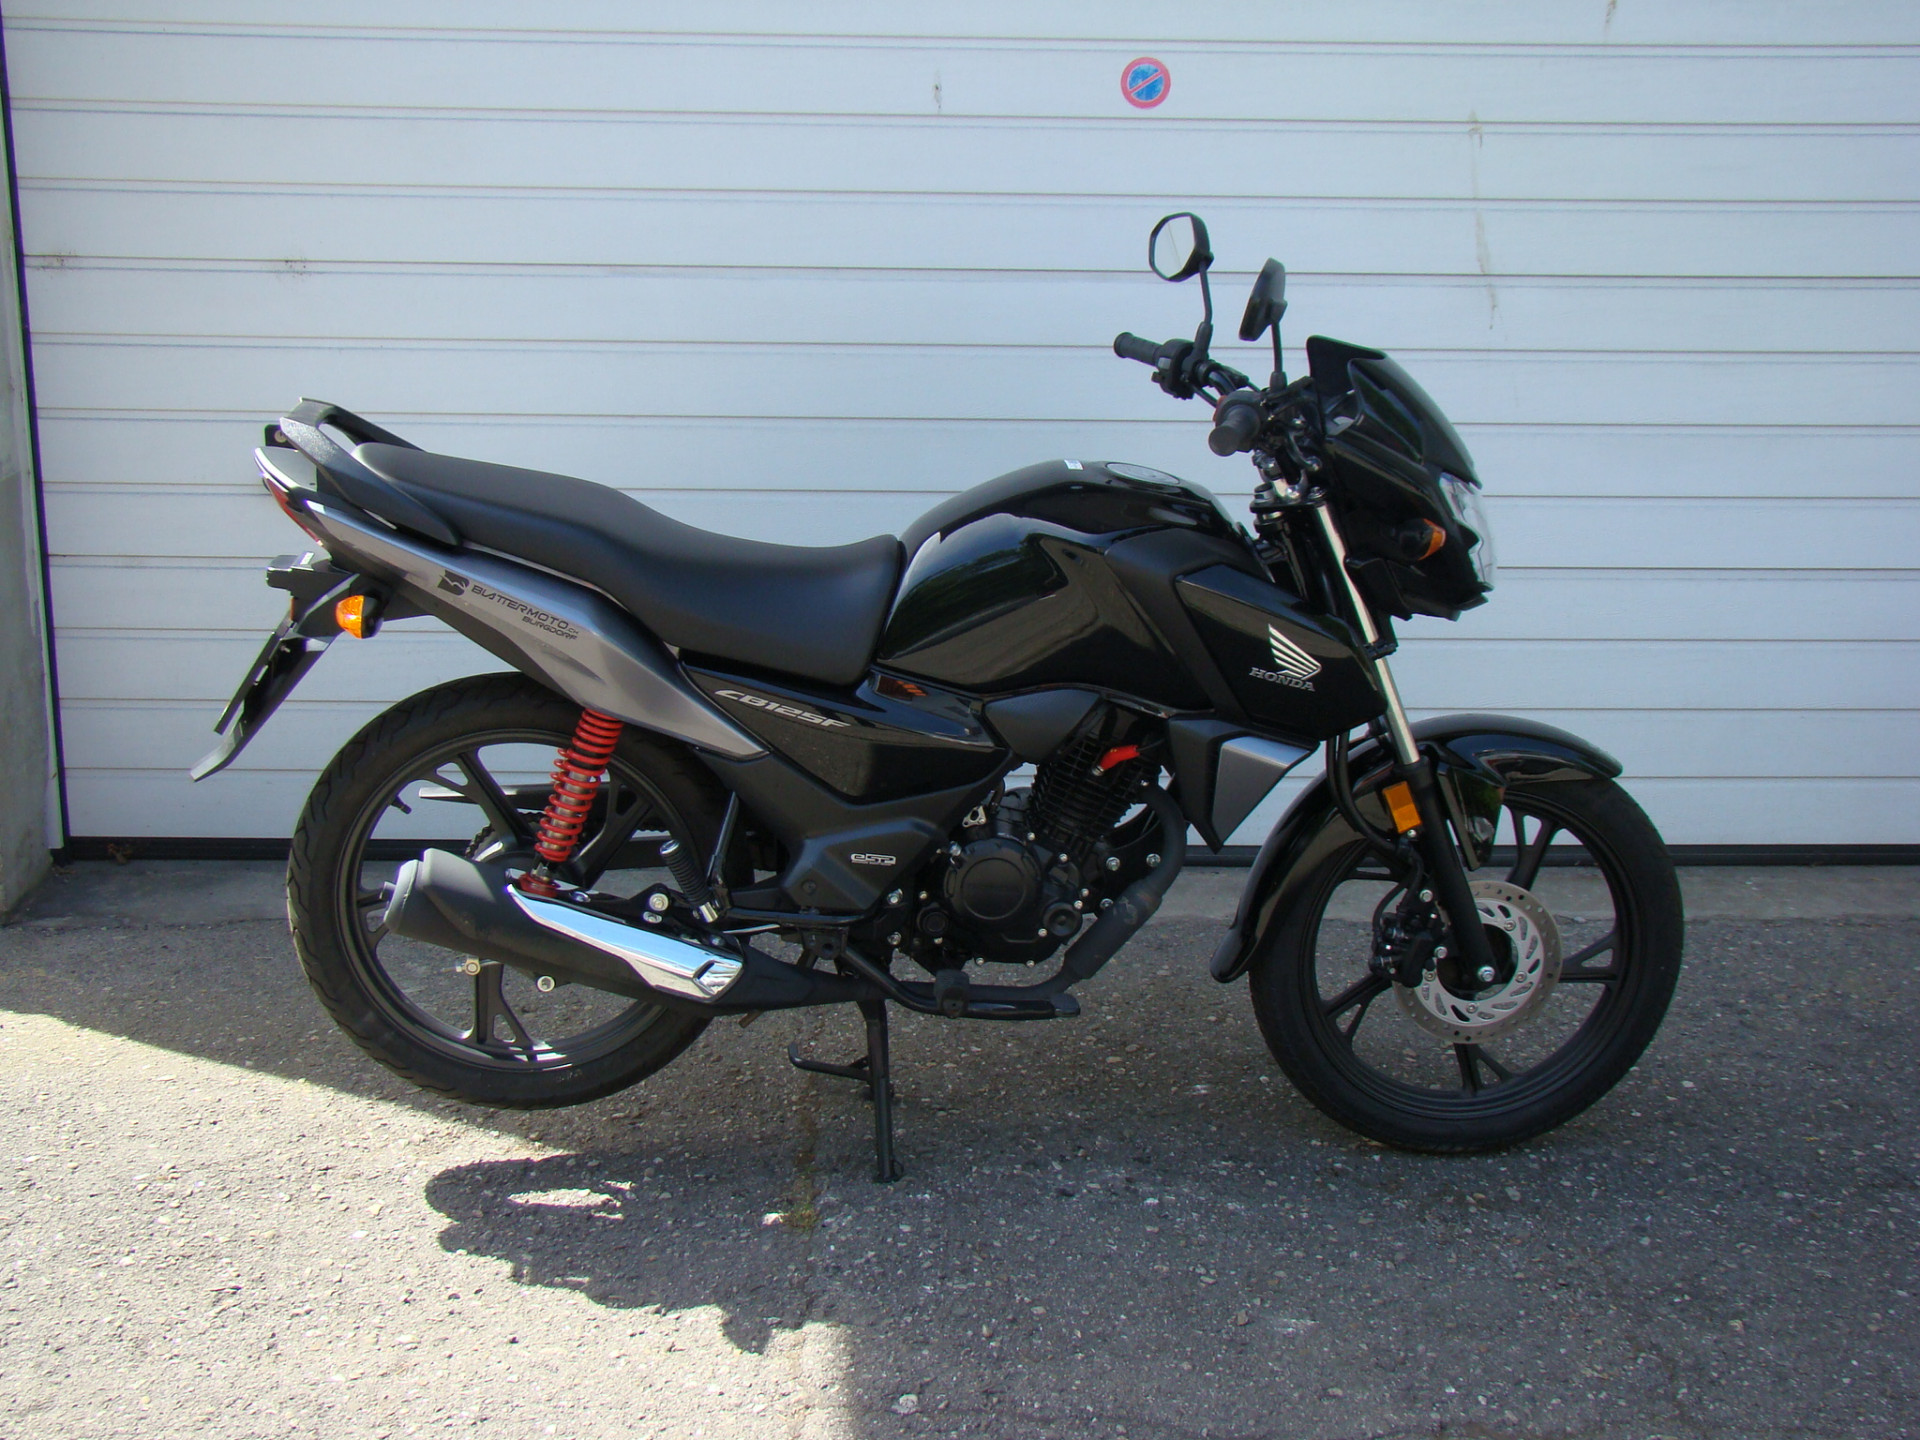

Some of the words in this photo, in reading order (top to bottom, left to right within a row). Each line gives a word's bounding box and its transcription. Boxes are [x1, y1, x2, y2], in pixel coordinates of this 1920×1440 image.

[522, 615, 578, 641] BURGDORF
[1249, 666, 1316, 692] HONDA
[714, 689, 851, 728] CB125F
